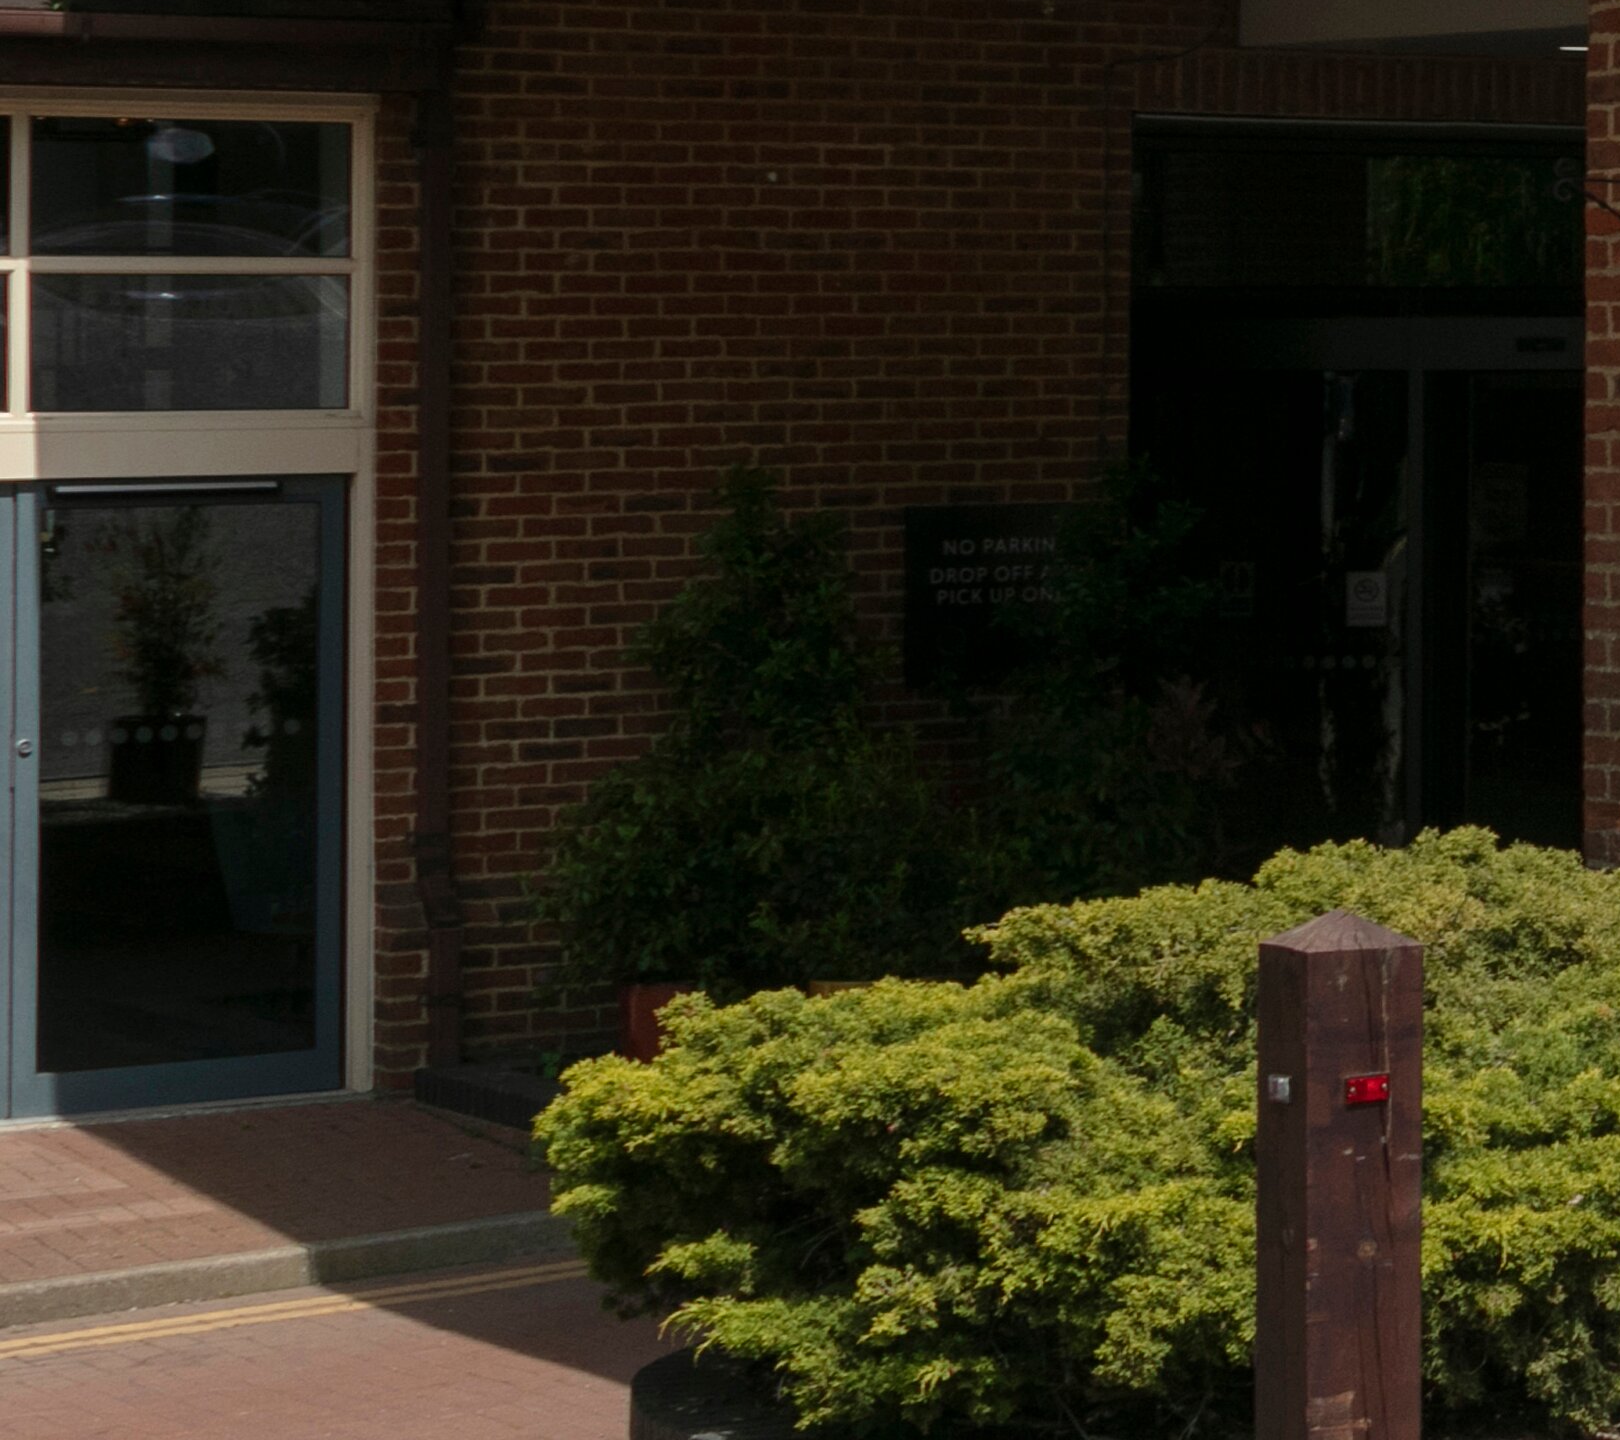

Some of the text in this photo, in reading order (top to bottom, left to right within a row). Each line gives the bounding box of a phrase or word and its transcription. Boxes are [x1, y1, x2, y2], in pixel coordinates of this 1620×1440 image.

[942, 536, 1056, 556] NO PARKIN
[929, 566, 988, 585] DROP
[994, 565, 1034, 582] OFF
[936, 588, 983, 606] PICK
[989, 587, 1016, 604] UP
